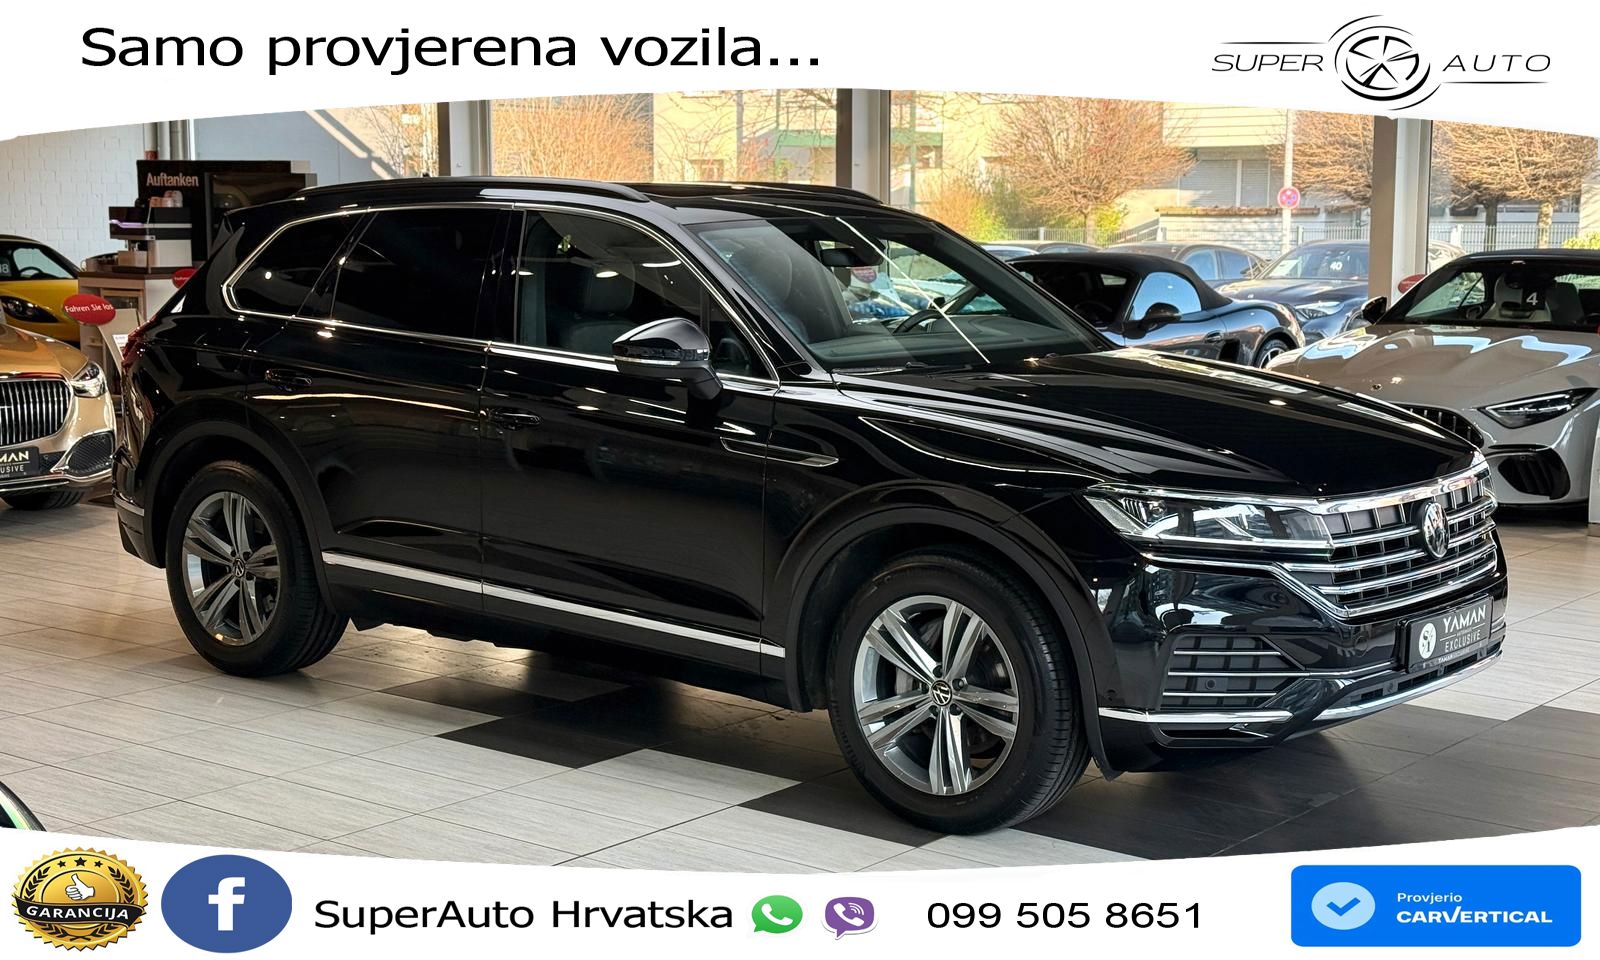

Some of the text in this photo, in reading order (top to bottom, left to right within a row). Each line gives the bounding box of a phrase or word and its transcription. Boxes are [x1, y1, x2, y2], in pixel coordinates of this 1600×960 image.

[146, 172, 200, 188] Auftanken
[1329, 261, 1343, 271] 40
[1526, 292, 1539, 306] 4
[64, 304, 90, 313] Fahren
[90, 303, 102, 311] Sie
[1443, 604, 1487, 634] YAMAN
[1444, 629, 1481, 653] EXCLUSIVE
